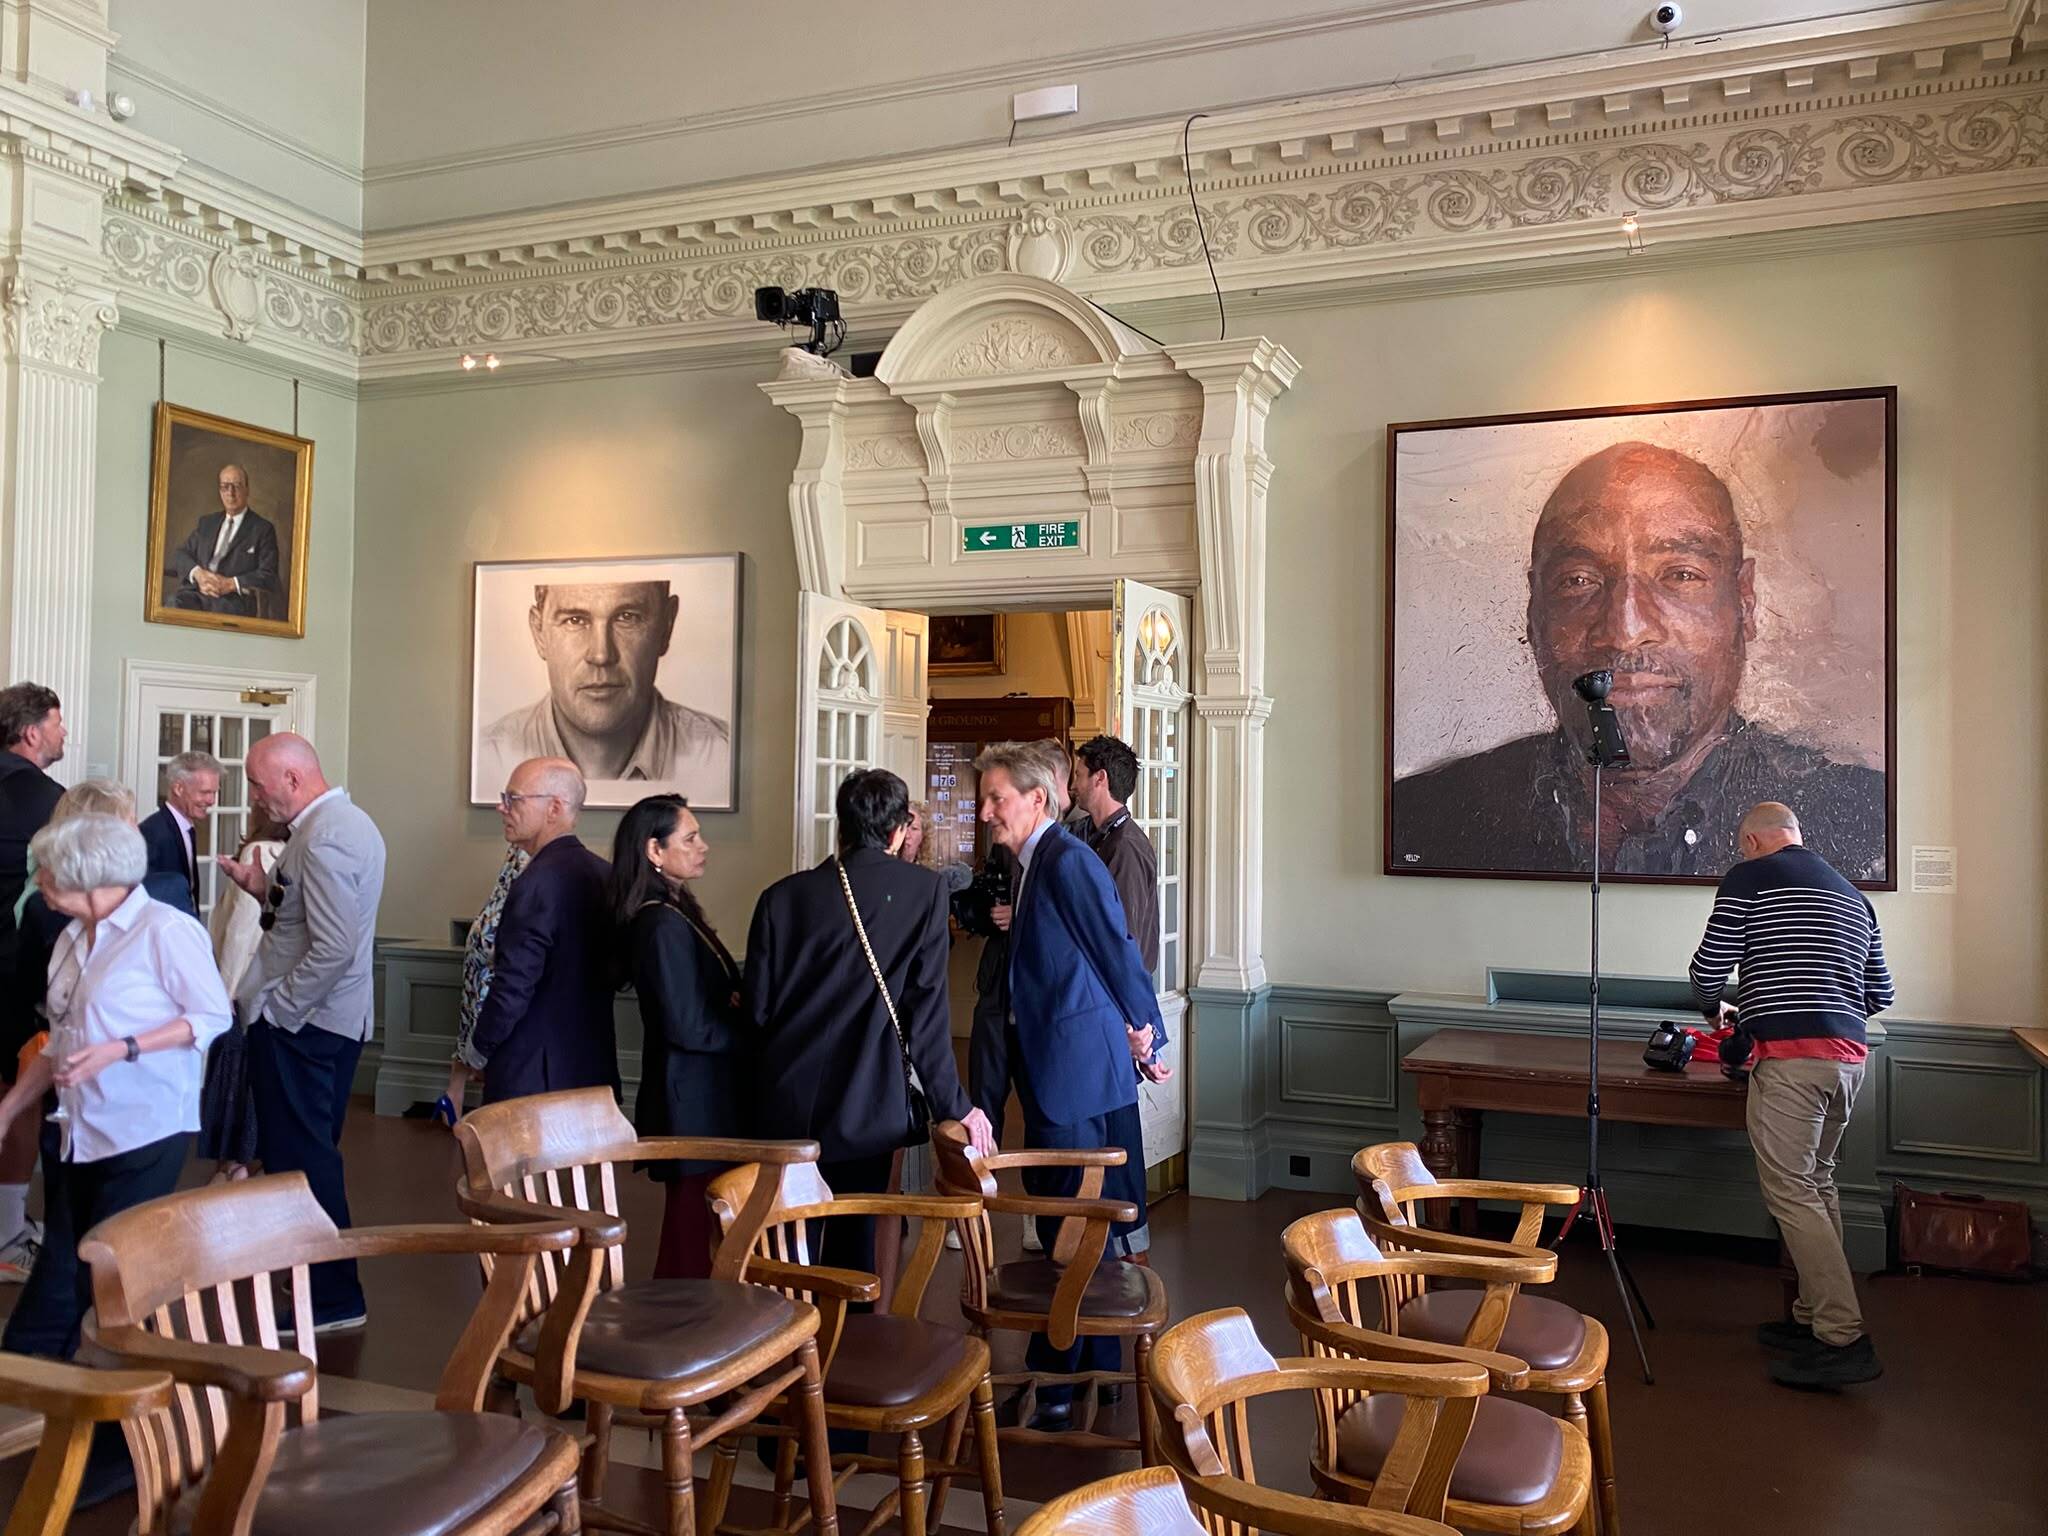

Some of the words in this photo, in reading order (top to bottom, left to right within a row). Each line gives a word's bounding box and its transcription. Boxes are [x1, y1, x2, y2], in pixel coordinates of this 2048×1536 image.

[1039, 524, 1065, 534] FIRE
[1039, 535, 1065, 546] EXIT
[938, 715, 998, 726] GROUNDS
[941, 777, 955, 786] 76
